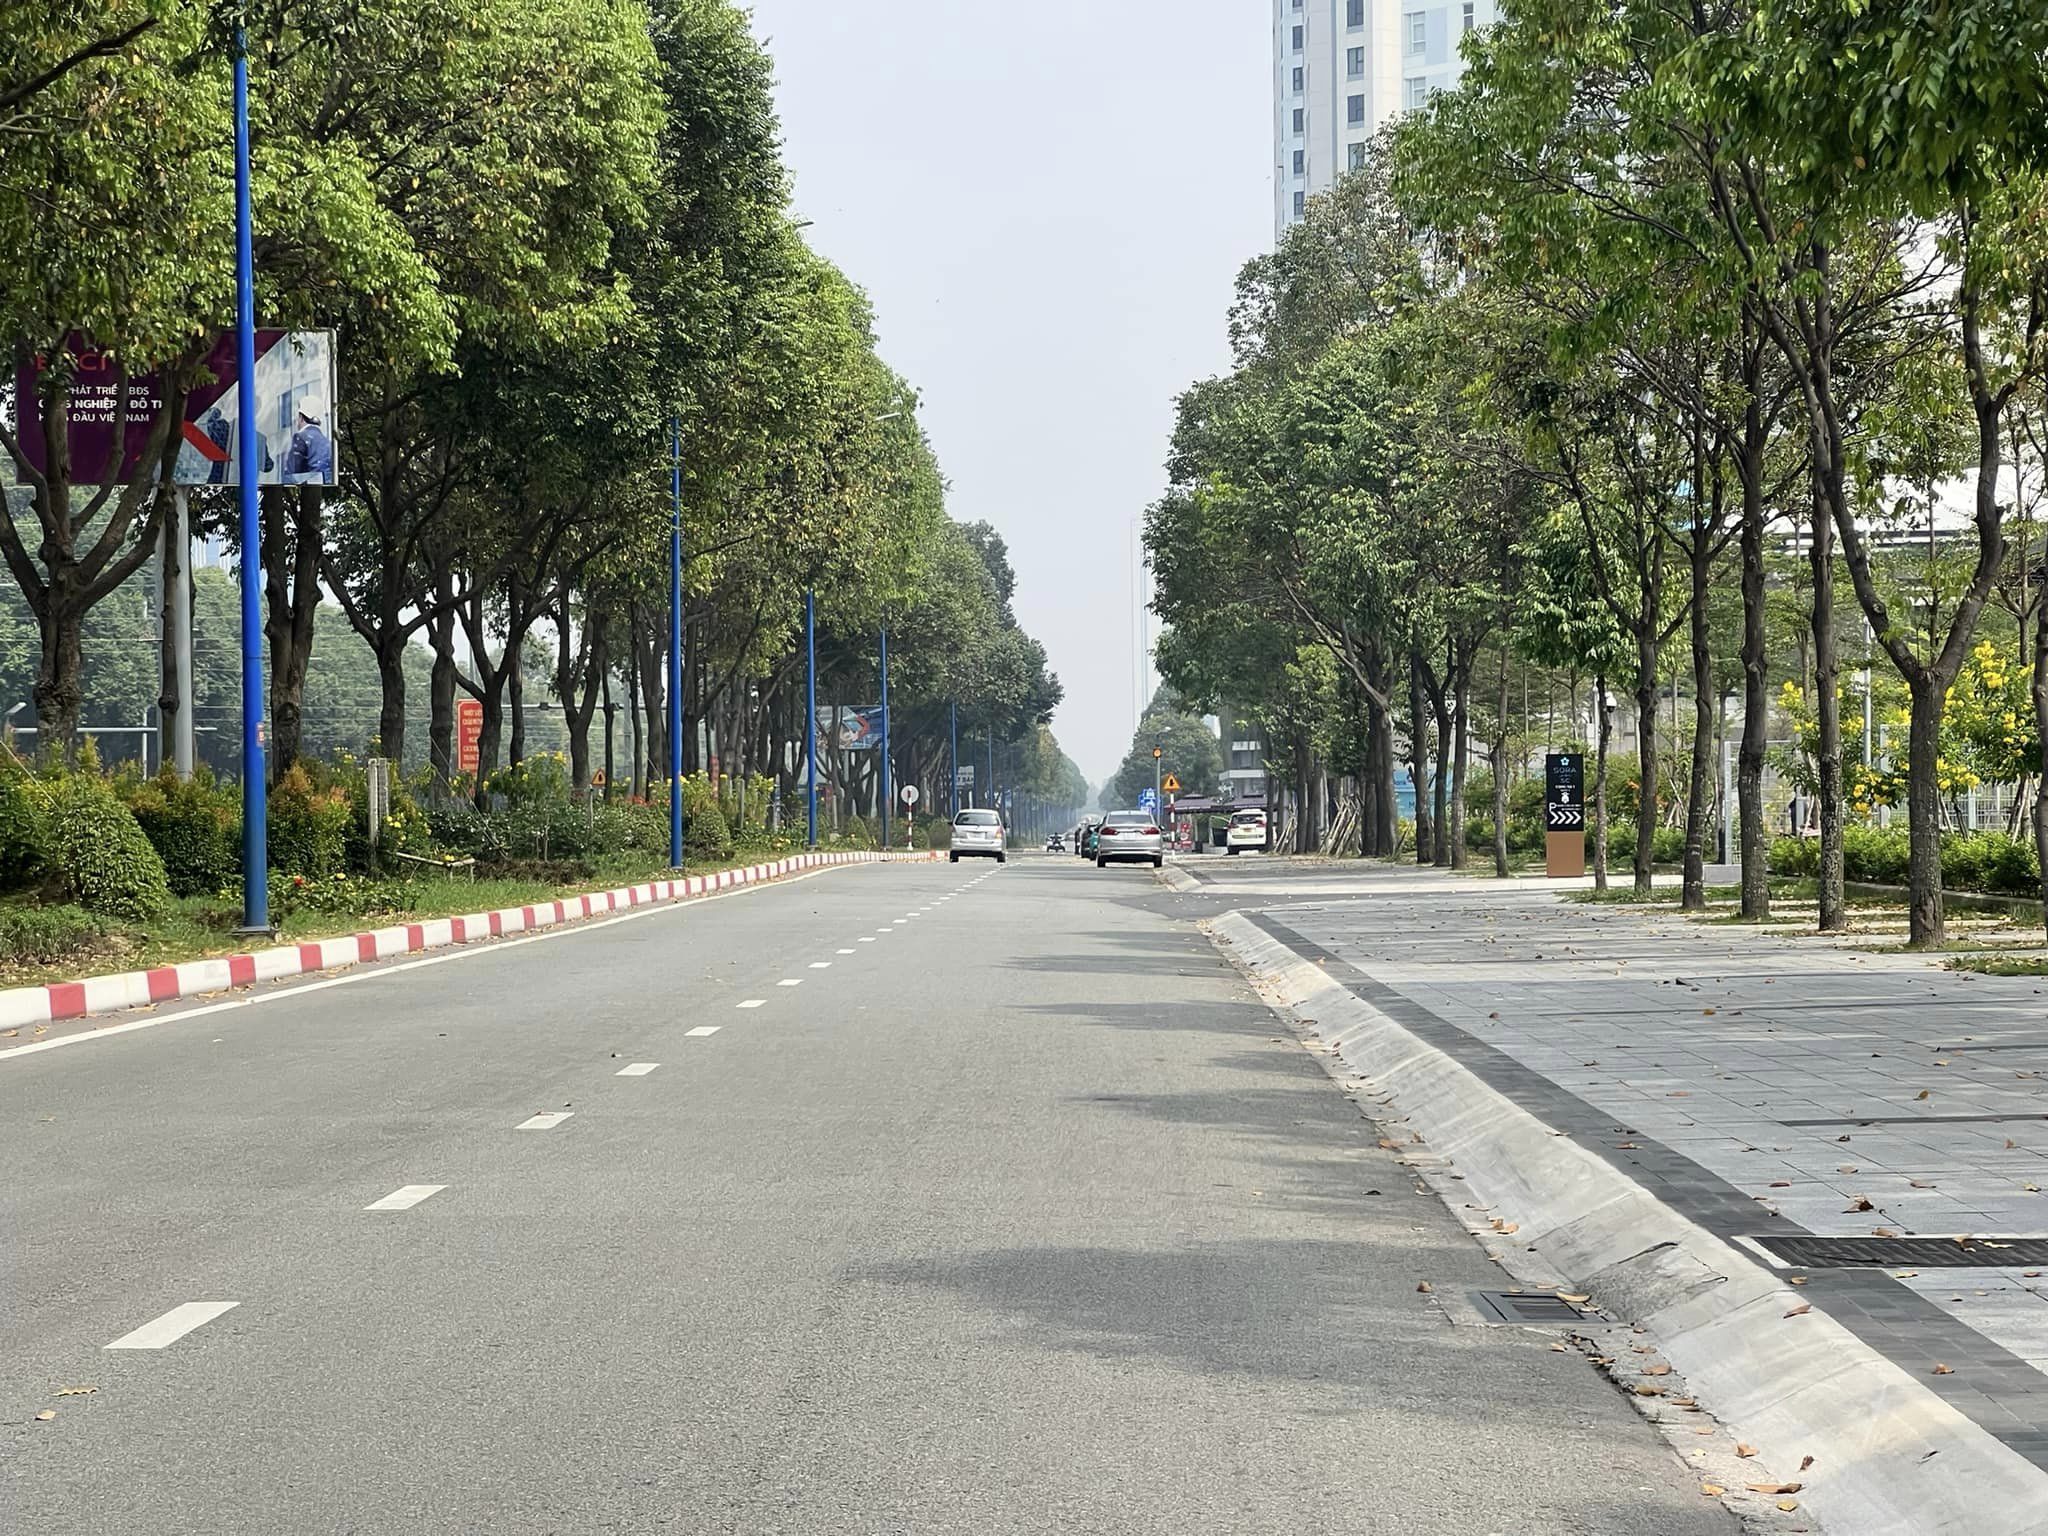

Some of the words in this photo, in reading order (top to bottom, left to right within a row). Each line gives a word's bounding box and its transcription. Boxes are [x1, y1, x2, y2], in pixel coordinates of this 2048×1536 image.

[74, 396, 118, 411] NGHIỆP
[129, 397, 148, 409] ĐÔ
[72, 411, 96, 422] ĐẦU
[125, 413, 150, 422] NAM
